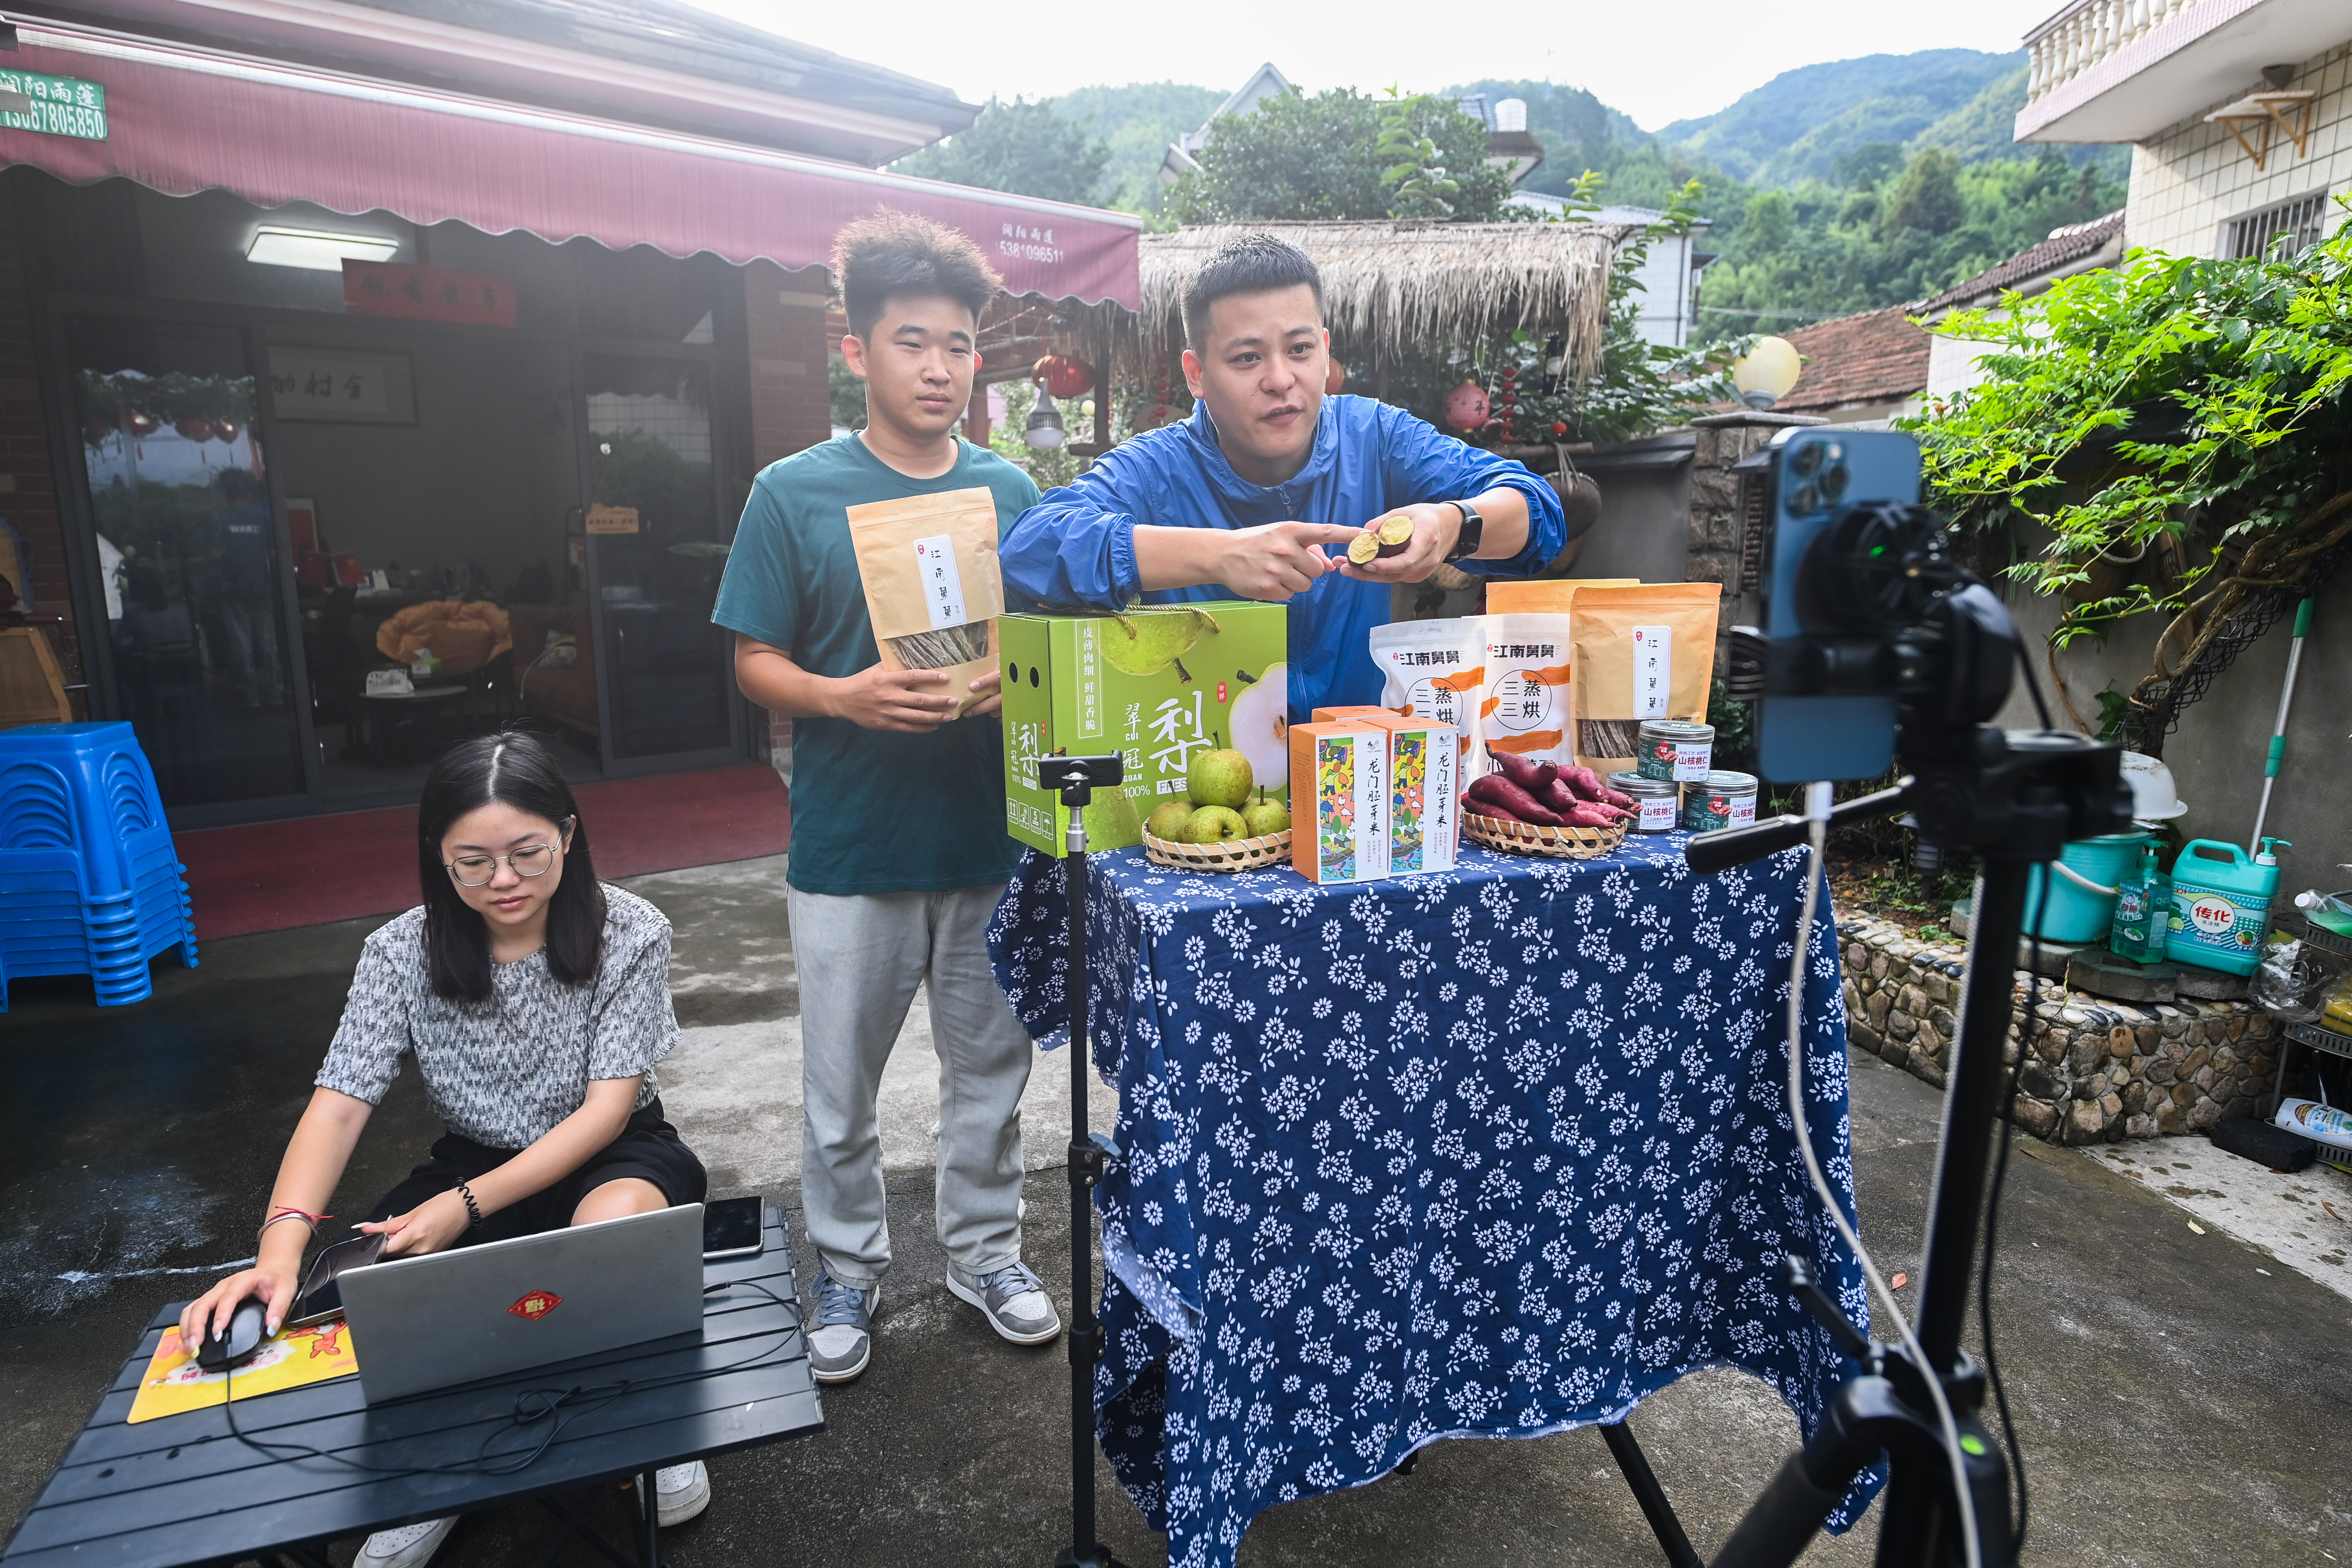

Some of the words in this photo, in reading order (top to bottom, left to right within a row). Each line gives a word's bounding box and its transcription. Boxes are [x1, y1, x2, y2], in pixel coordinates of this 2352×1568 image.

[931, 550, 952, 620] 江南舅舅
[1083, 627, 1094, 676] 皮薄肉细
[1399, 651, 1459, 665] 江南舅舅
[1494, 644, 1554, 658] 江南舅舅
[1647, 639, 1658, 711] 江南舅舅
[1084, 682, 1095, 730] 鲜甜香脆
[1125, 732, 1138, 740] CUI
[1678, 756, 1708, 765] 山核桃仁
[1012, 774, 1021, 784] 100%
[1023, 778, 1036, 790] FRESH
[1123, 773, 1142, 782] GUAN
[1123, 784, 1150, 798] 100%
[1367, 757, 1381, 836] 龙门胚芽米
[1435, 752, 1450, 828] 龙门胚芽米
[1644, 806, 1674, 816] 山核桃仁
[2195, 906, 2231, 923] 传化
[2201, 919, 2219, 927] 洗洁精
